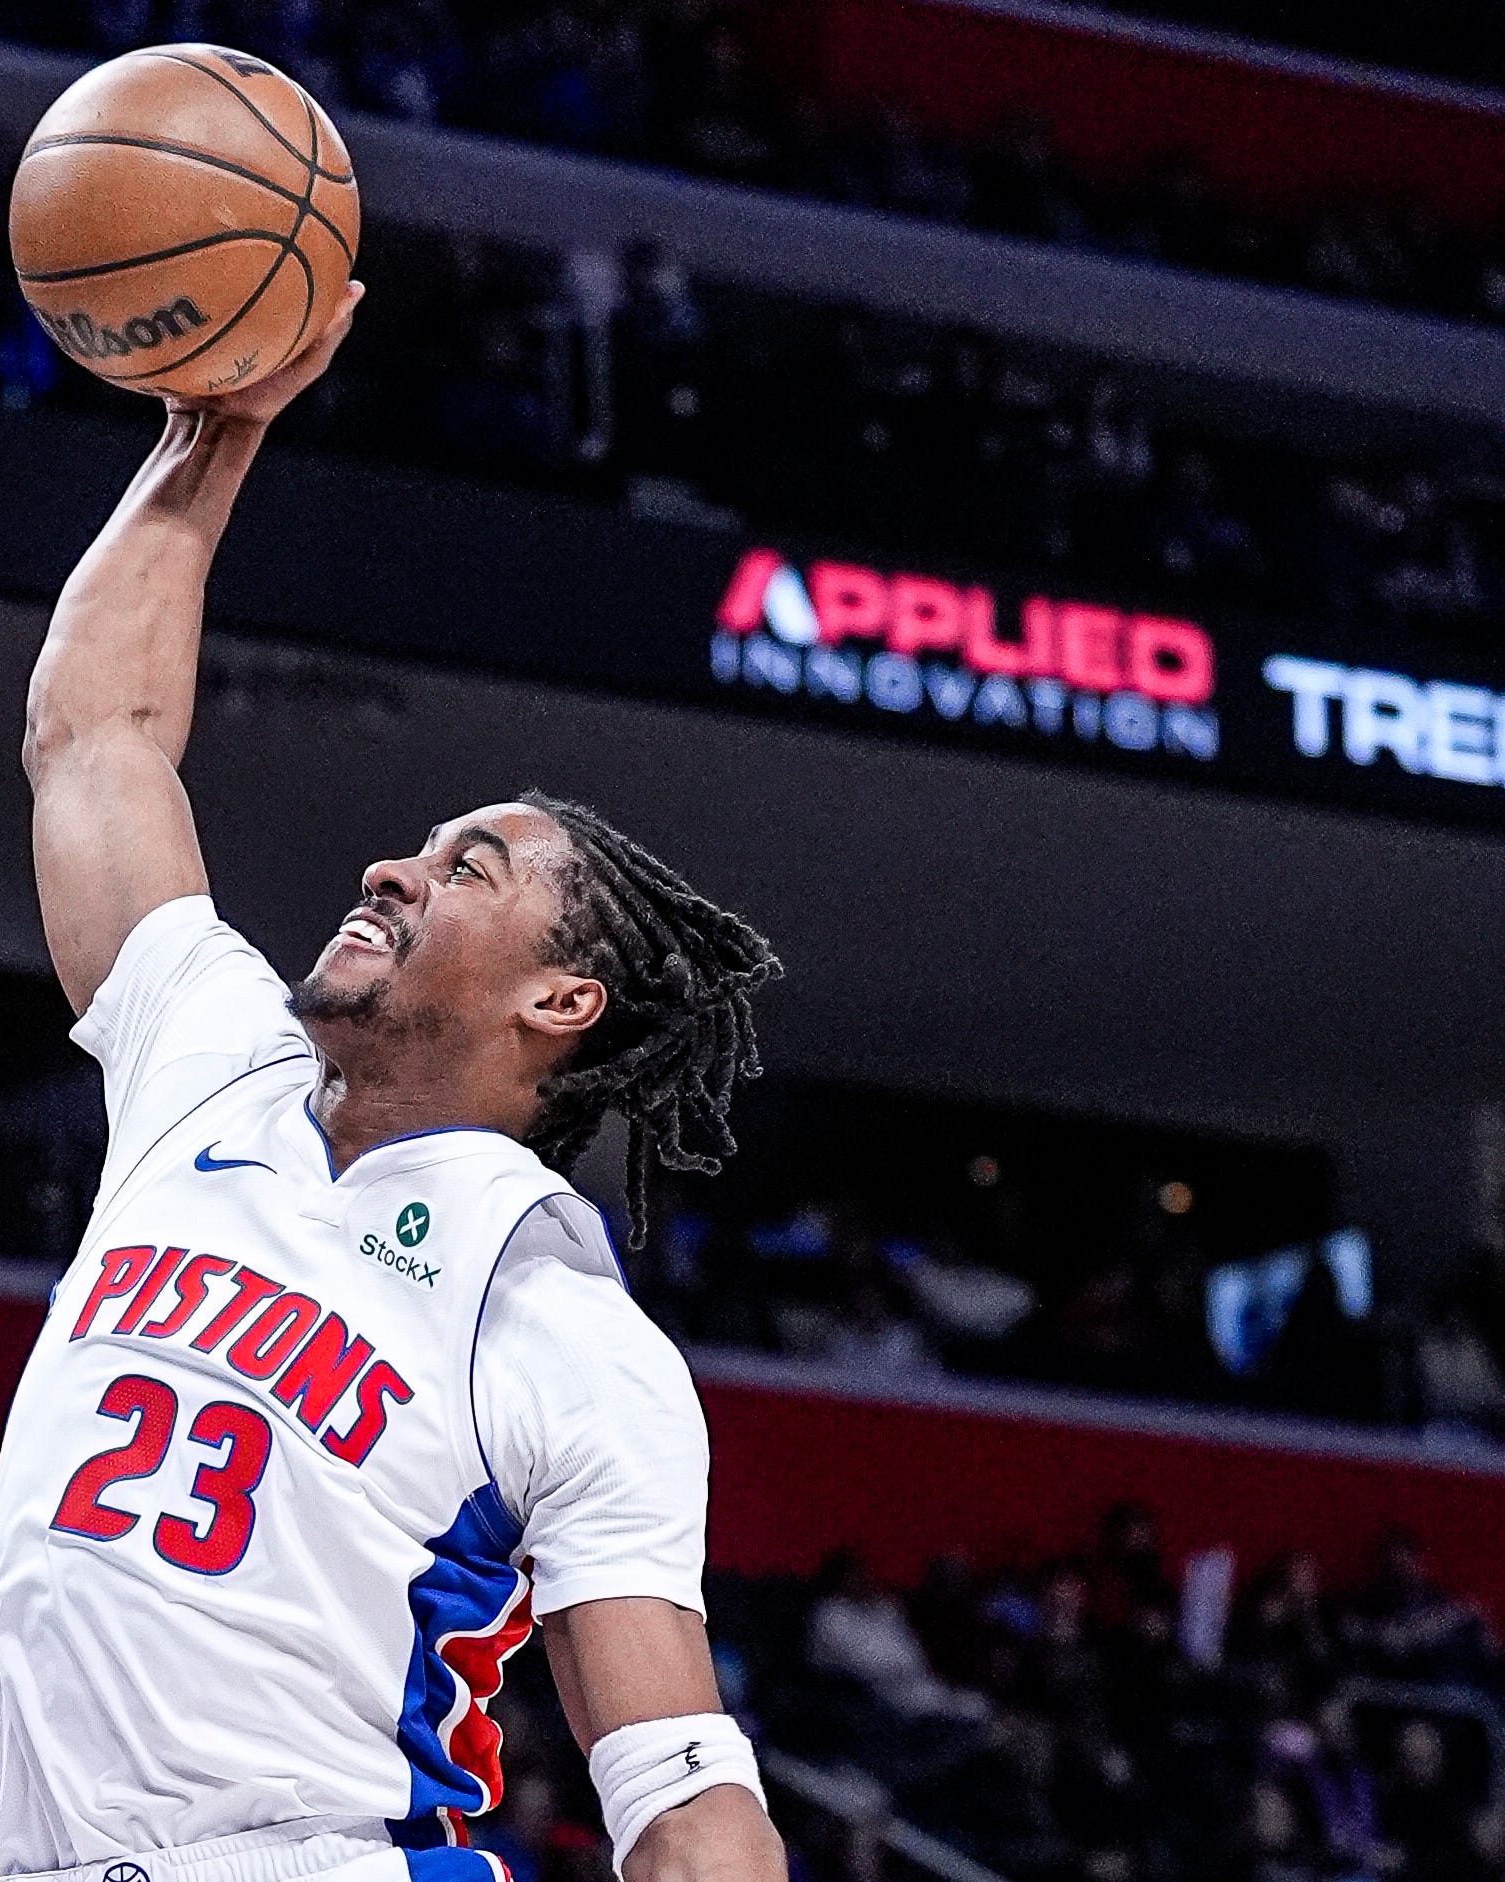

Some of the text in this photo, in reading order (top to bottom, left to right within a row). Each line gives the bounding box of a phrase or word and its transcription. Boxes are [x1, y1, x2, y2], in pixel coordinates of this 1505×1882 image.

[710, 628, 1220, 763] INNOVATION
[715, 546, 1216, 706] APPLIED
[1261, 654, 1505, 788] TRE
[360, 1234, 442, 1288] StockX
[69, 1244, 415, 1468] PISTONS
[49, 1374, 273, 1576] 23
